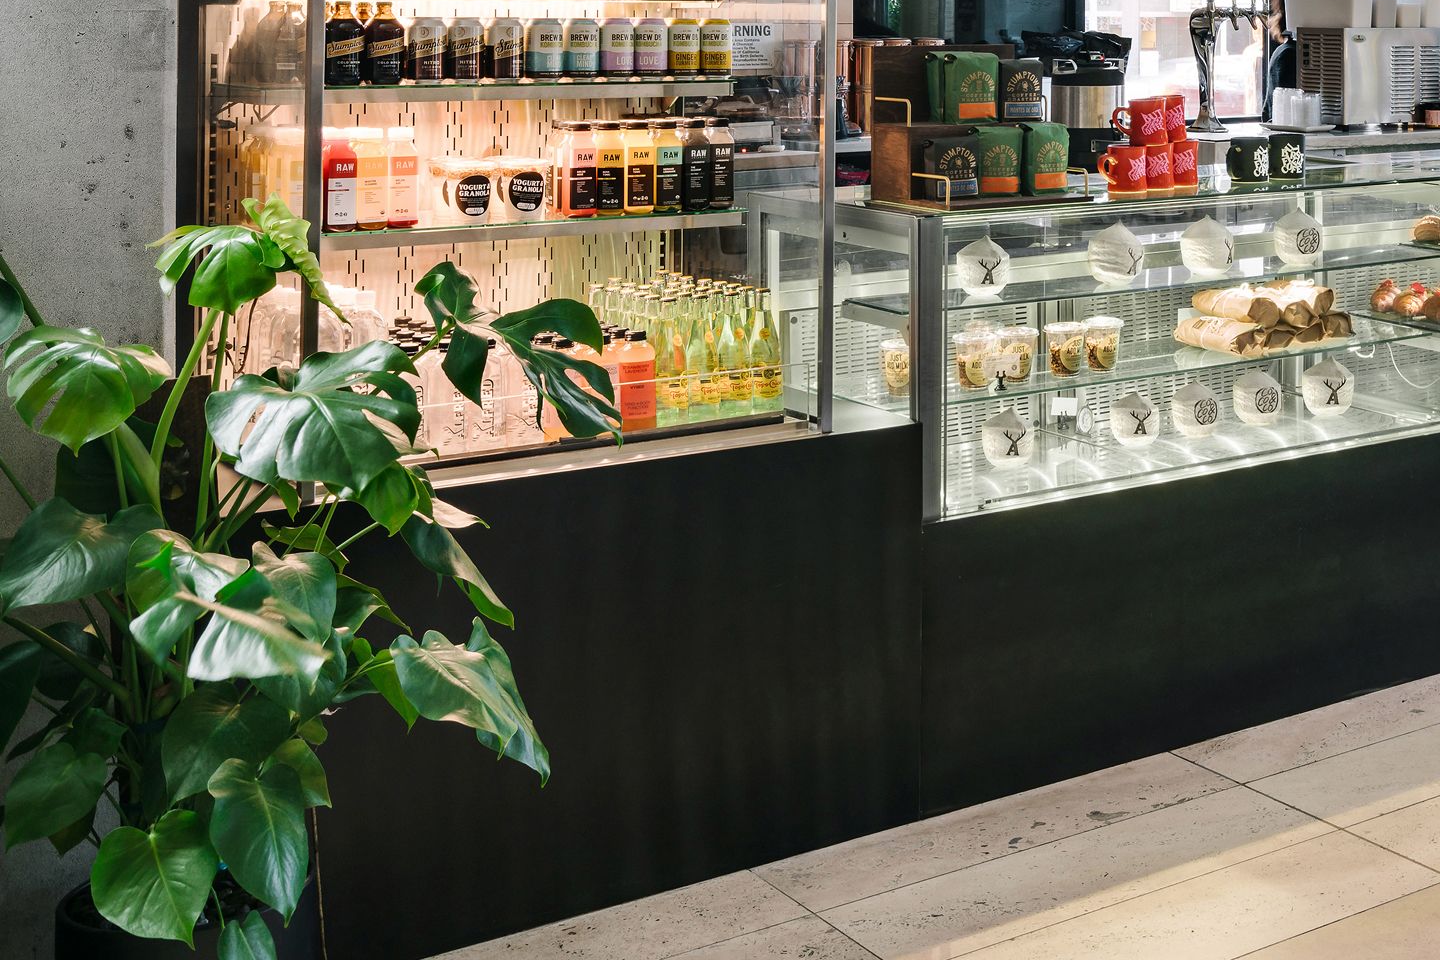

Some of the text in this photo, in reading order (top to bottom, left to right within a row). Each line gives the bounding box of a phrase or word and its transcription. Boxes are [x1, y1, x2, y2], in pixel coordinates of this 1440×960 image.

[616, 56, 633, 65] LOVE
[640, 56, 658, 65] LOVE
[960, 71, 995, 92] STUMPTOWN
[1007, 71, 1040, 93] STUMPTOWN
[939, 146, 977, 170] STUMPTOWN
[983, 144, 1018, 167] STUMPTOWN
[1037, 140, 1066, 163] STUMPTOWN
[336, 163, 354, 172] RAW
[396, 161, 414, 169] RAW
[1012, 345, 1025, 354] JUST
